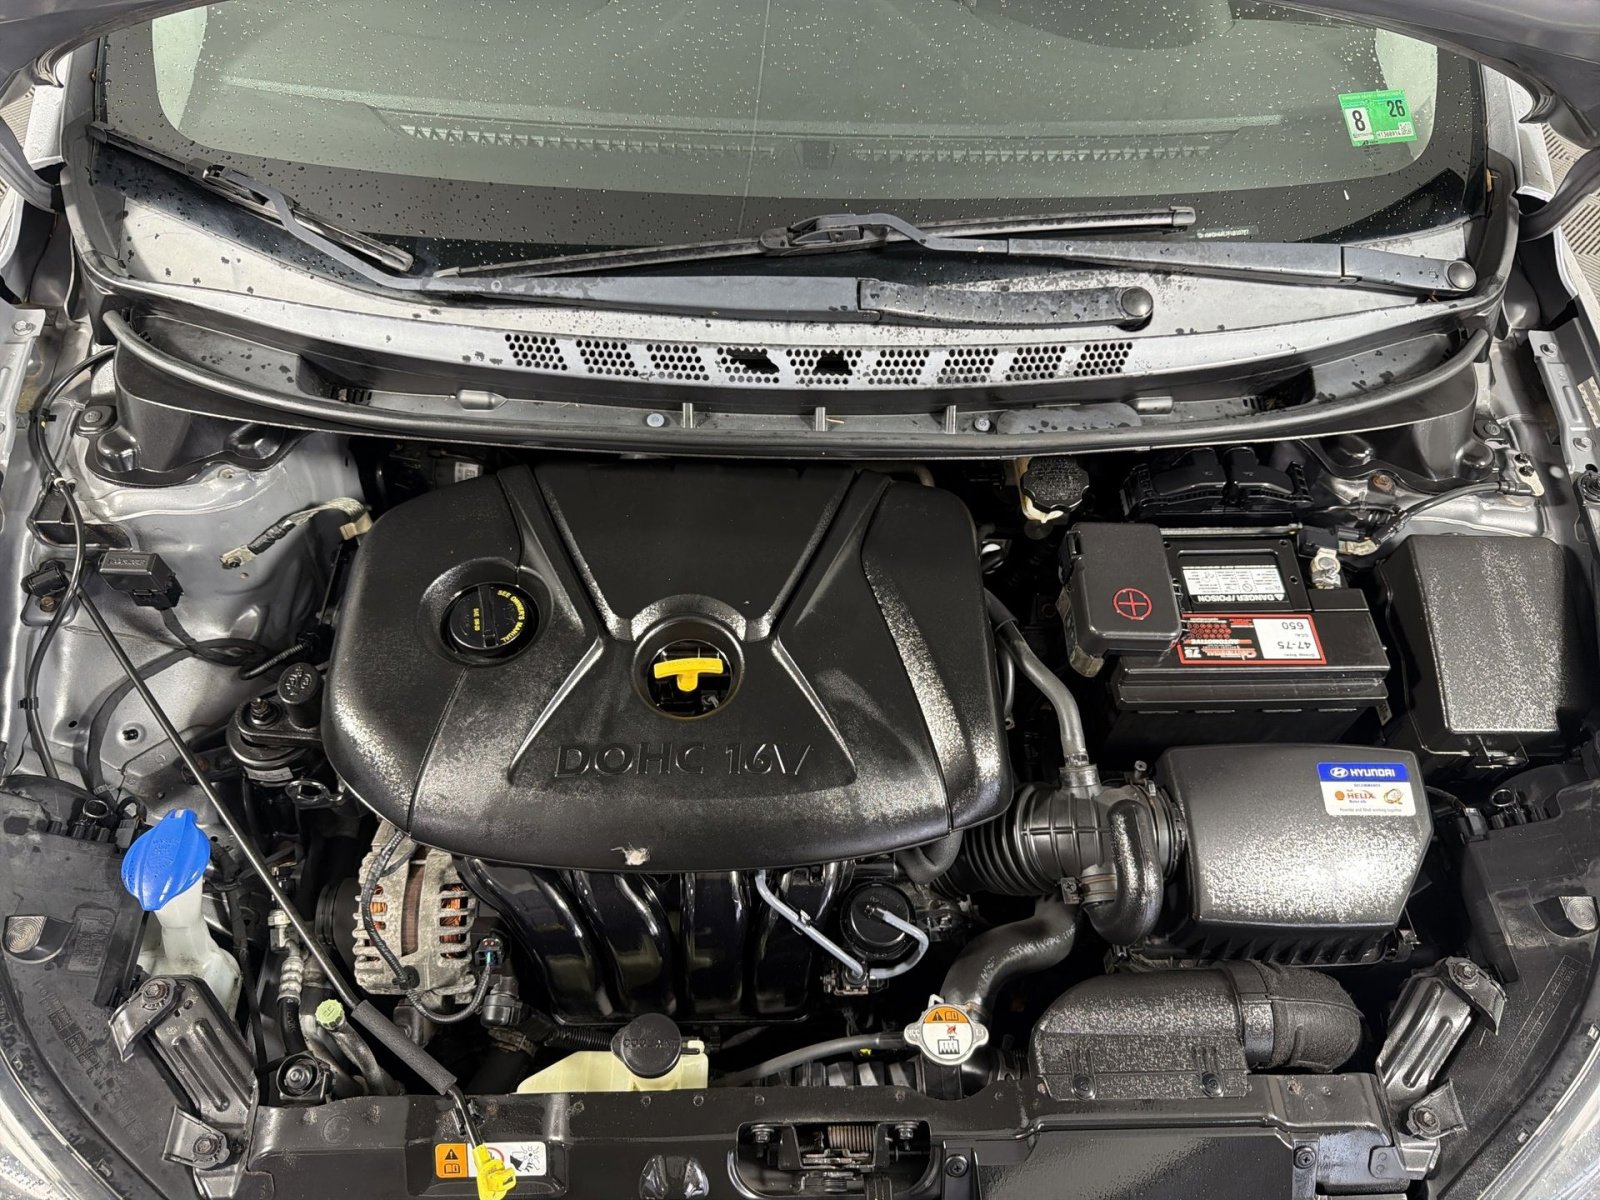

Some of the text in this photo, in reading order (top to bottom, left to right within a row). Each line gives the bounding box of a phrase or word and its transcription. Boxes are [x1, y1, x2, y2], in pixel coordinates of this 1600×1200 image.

[1387, 99, 1406, 118] 26
[1352, 110, 1366, 132] 8
[497, 590, 512, 599] SEE
[1236, 594, 1275, 602] DANGER
[1281, 621, 1305, 631] 650
[500, 621, 524, 642] MANUAL
[1277, 641, 1312, 650] 47-75
[553, 743, 811, 777] DOHC 16V
[1350, 768, 1396, 777] HYUNDAI
[1346, 792, 1376, 800] HELIX
